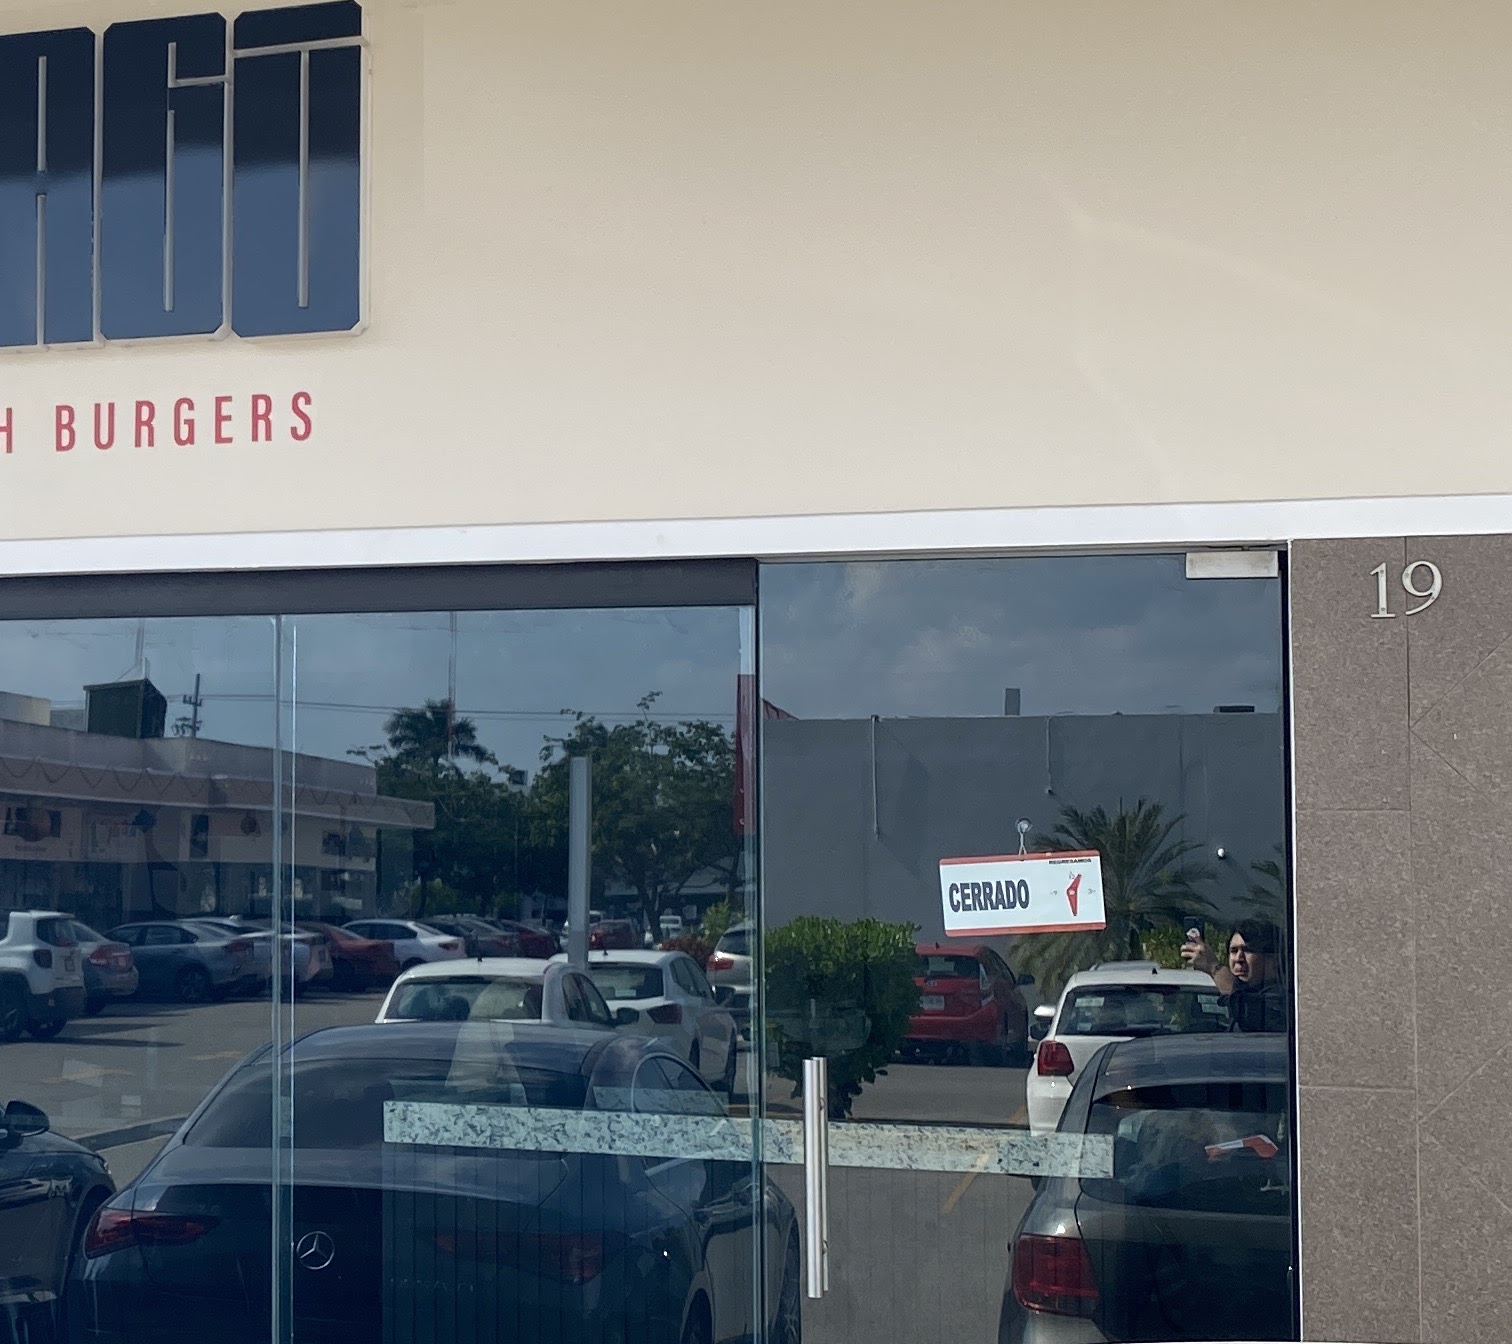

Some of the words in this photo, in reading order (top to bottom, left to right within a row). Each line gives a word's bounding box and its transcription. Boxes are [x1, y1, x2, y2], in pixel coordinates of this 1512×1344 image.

[54, 391, 315, 453] BURGERS
[1369, 560, 1443, 619] 19
[948, 878, 1030, 913] CERRADO
